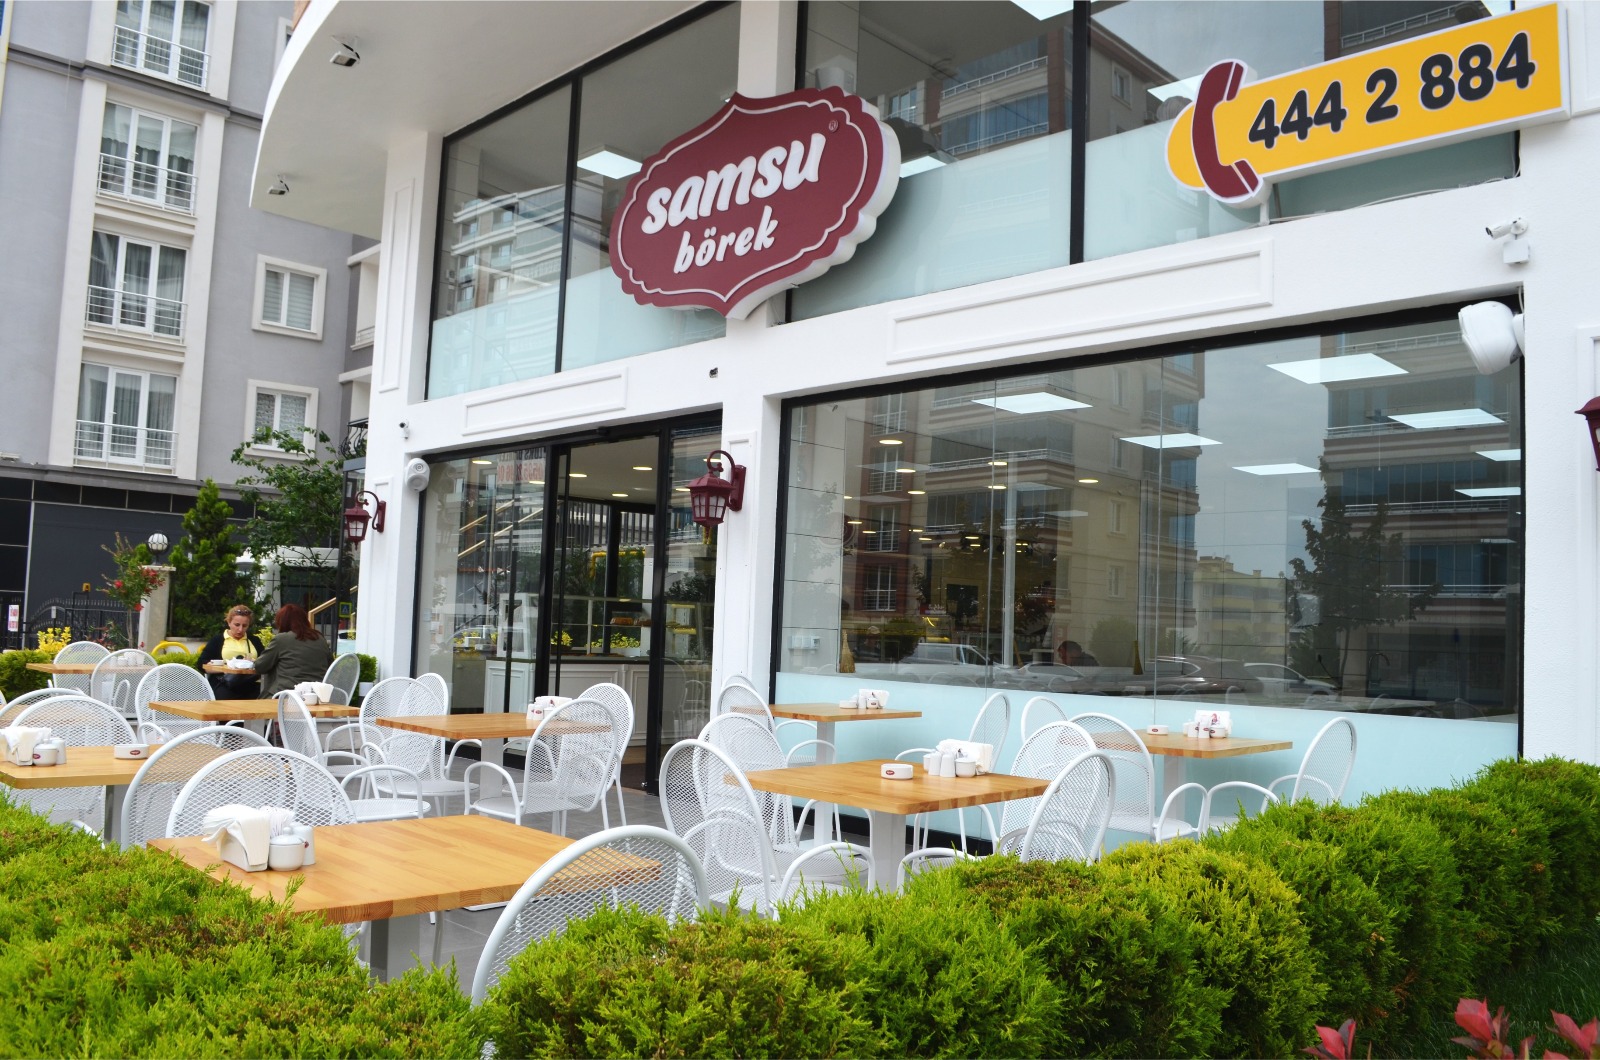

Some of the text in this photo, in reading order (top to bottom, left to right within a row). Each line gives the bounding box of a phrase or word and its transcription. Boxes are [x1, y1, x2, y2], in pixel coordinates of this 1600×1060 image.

[1248, 32, 1536, 149] 444 2 884
[641, 133, 826, 234] samsu
[673, 205, 779, 274] börek
